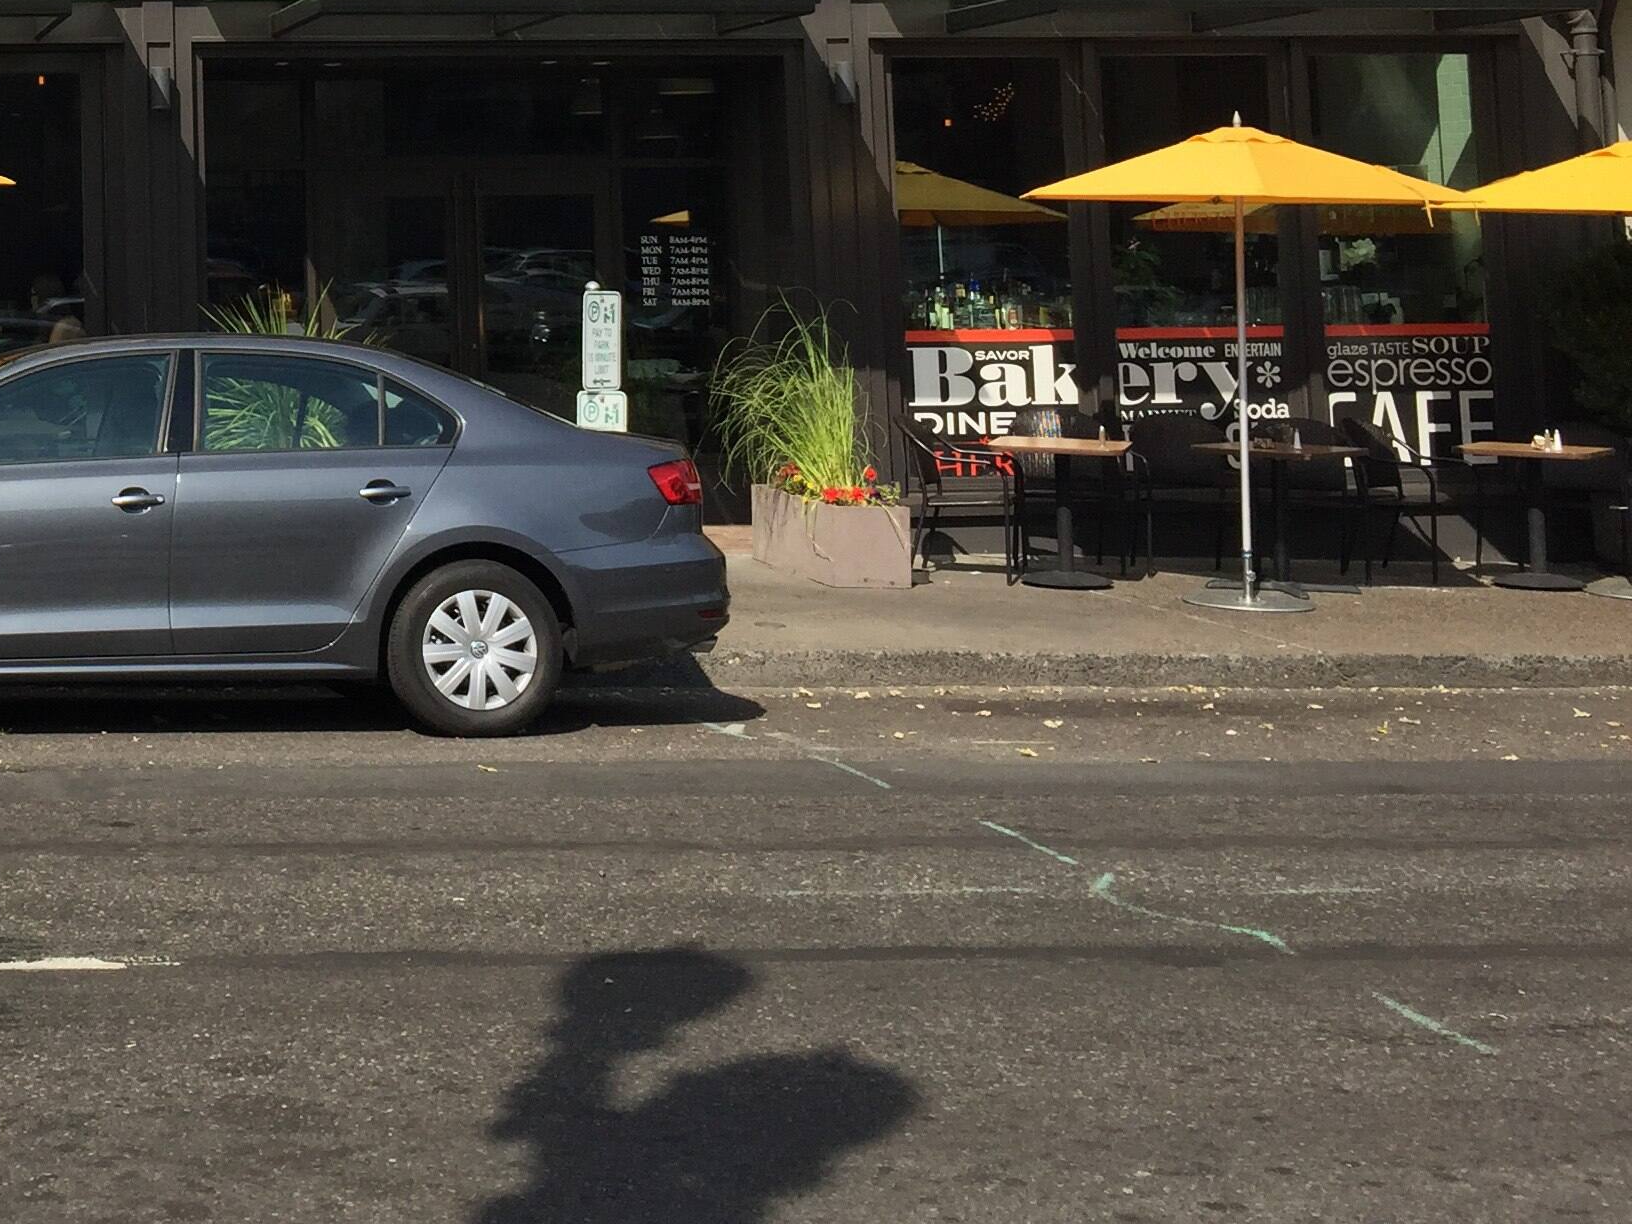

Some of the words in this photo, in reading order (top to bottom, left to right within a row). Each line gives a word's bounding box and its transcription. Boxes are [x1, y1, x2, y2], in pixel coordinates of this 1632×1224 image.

[640, 235, 658, 244] SUN
[640, 246, 662, 254] MON
[641, 256, 658, 265] TUE
[641, 266, 661, 275] WED
[642, 277, 660, 286] THU
[642, 287, 655, 296] FRI
[642, 297, 658, 306] SAT
[1118, 342, 1216, 359] Welcome
[1224, 342, 1282, 357] ENERTAIN
[1327, 341, 1369, 360] glaze
[1370, 342, 1409, 355] TASTE
[1412, 336, 1490, 354] SOUP
[974, 350, 1030, 361] SAVOR
[906, 344, 1079, 407] Bak
[1327, 358, 1493, 395] espresso
